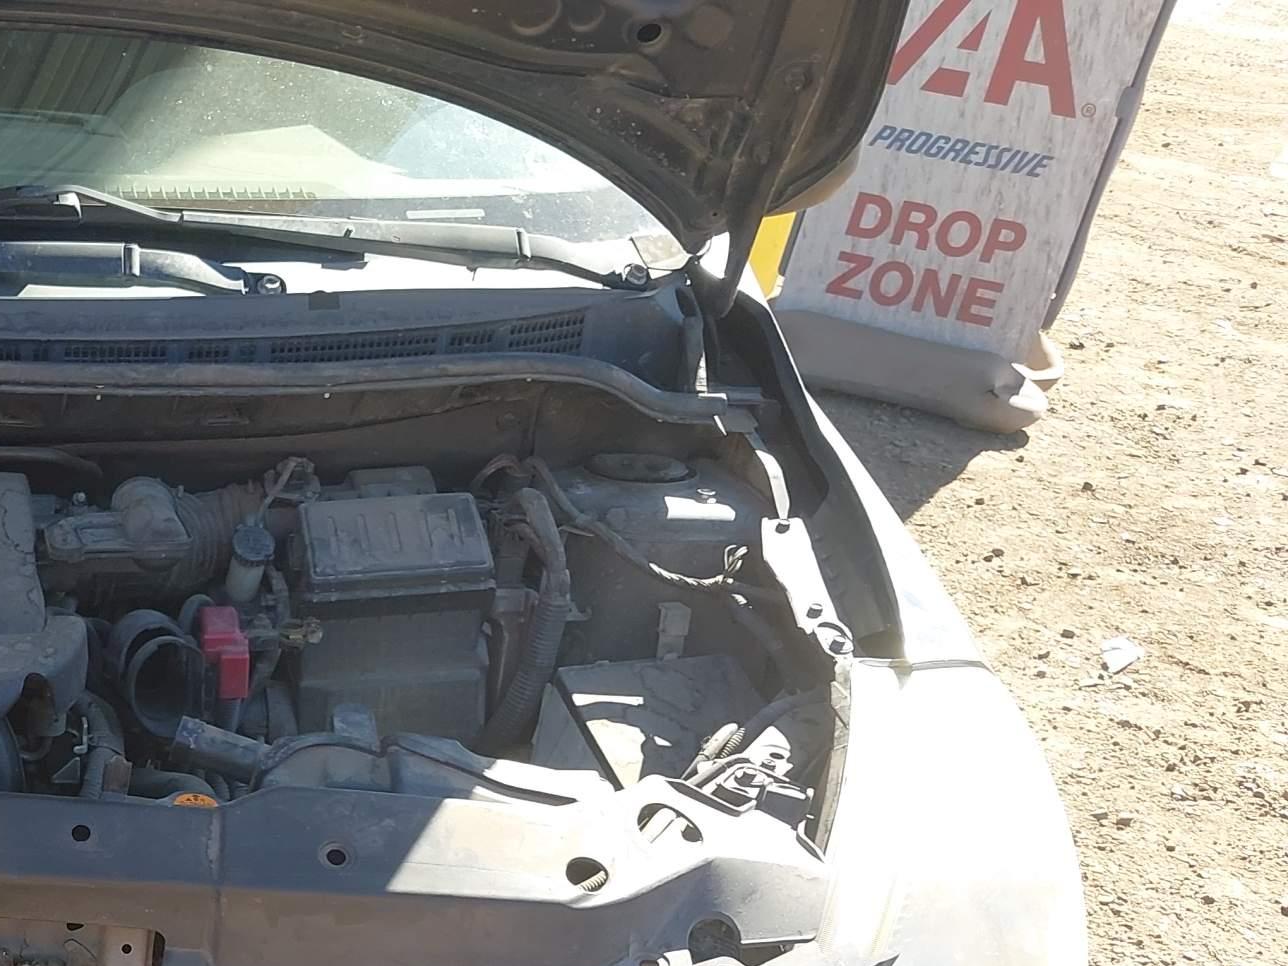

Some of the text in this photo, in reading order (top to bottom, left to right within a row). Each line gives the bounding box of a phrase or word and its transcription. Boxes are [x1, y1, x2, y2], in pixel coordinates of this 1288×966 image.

[868, 124, 1055, 178] PROGRESSIVE
[845, 191, 1028, 264] DROP
[825, 250, 1005, 328] ZONE
